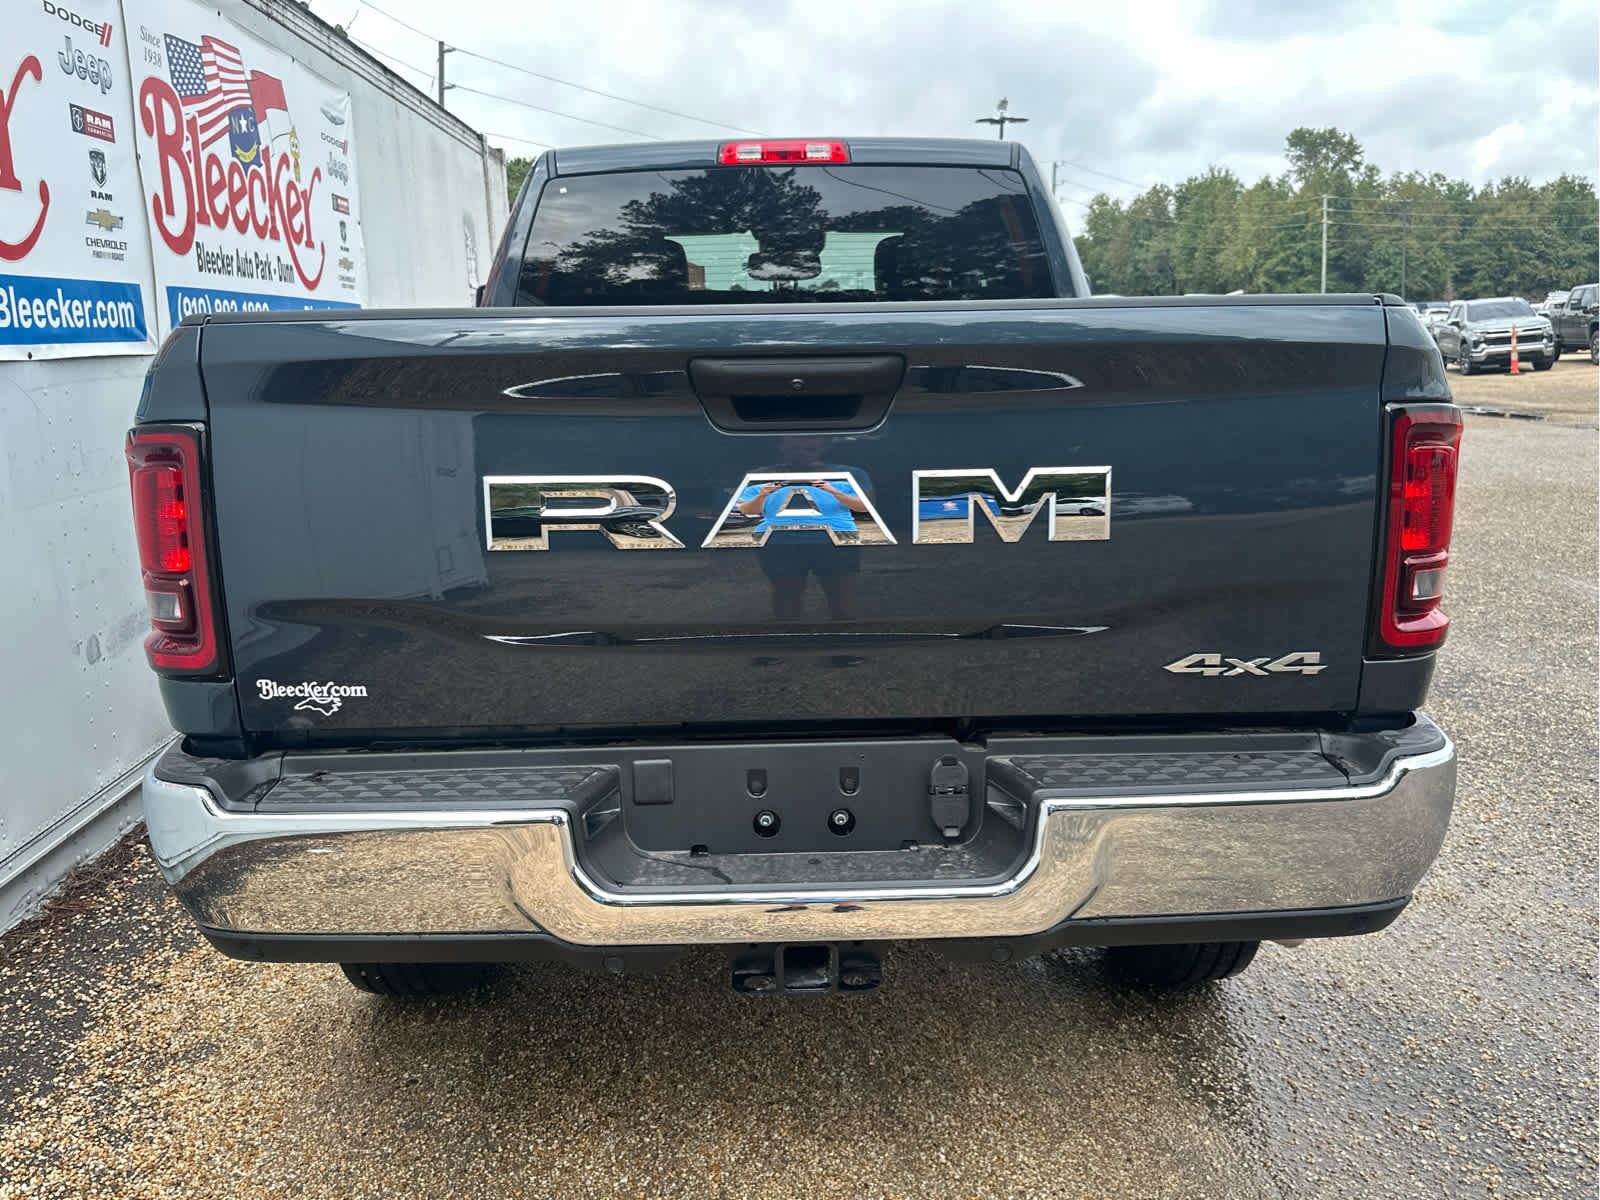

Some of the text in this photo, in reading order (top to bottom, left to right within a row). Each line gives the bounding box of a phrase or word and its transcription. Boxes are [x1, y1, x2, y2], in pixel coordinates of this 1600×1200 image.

[43, 1, 104, 37] DODGE
[140, 25, 161, 48] Since
[57, 35, 113, 95] Jeep
[144, 46, 162, 68] 1938
[86, 113, 112, 130] RAM
[91, 190, 113, 202] RAM
[139, 76, 325, 291] Bleecker
[86, 237, 128, 250] CHEVROLET
[195, 241, 234, 277] Bleecker
[236, 247, 254, 279] Auto
[254, 250, 273, 281] Park
[277, 255, 295, 284] Dunn
[482, 465, 1112, 551] RAM
[1162, 651, 1328, 676] 4x4
